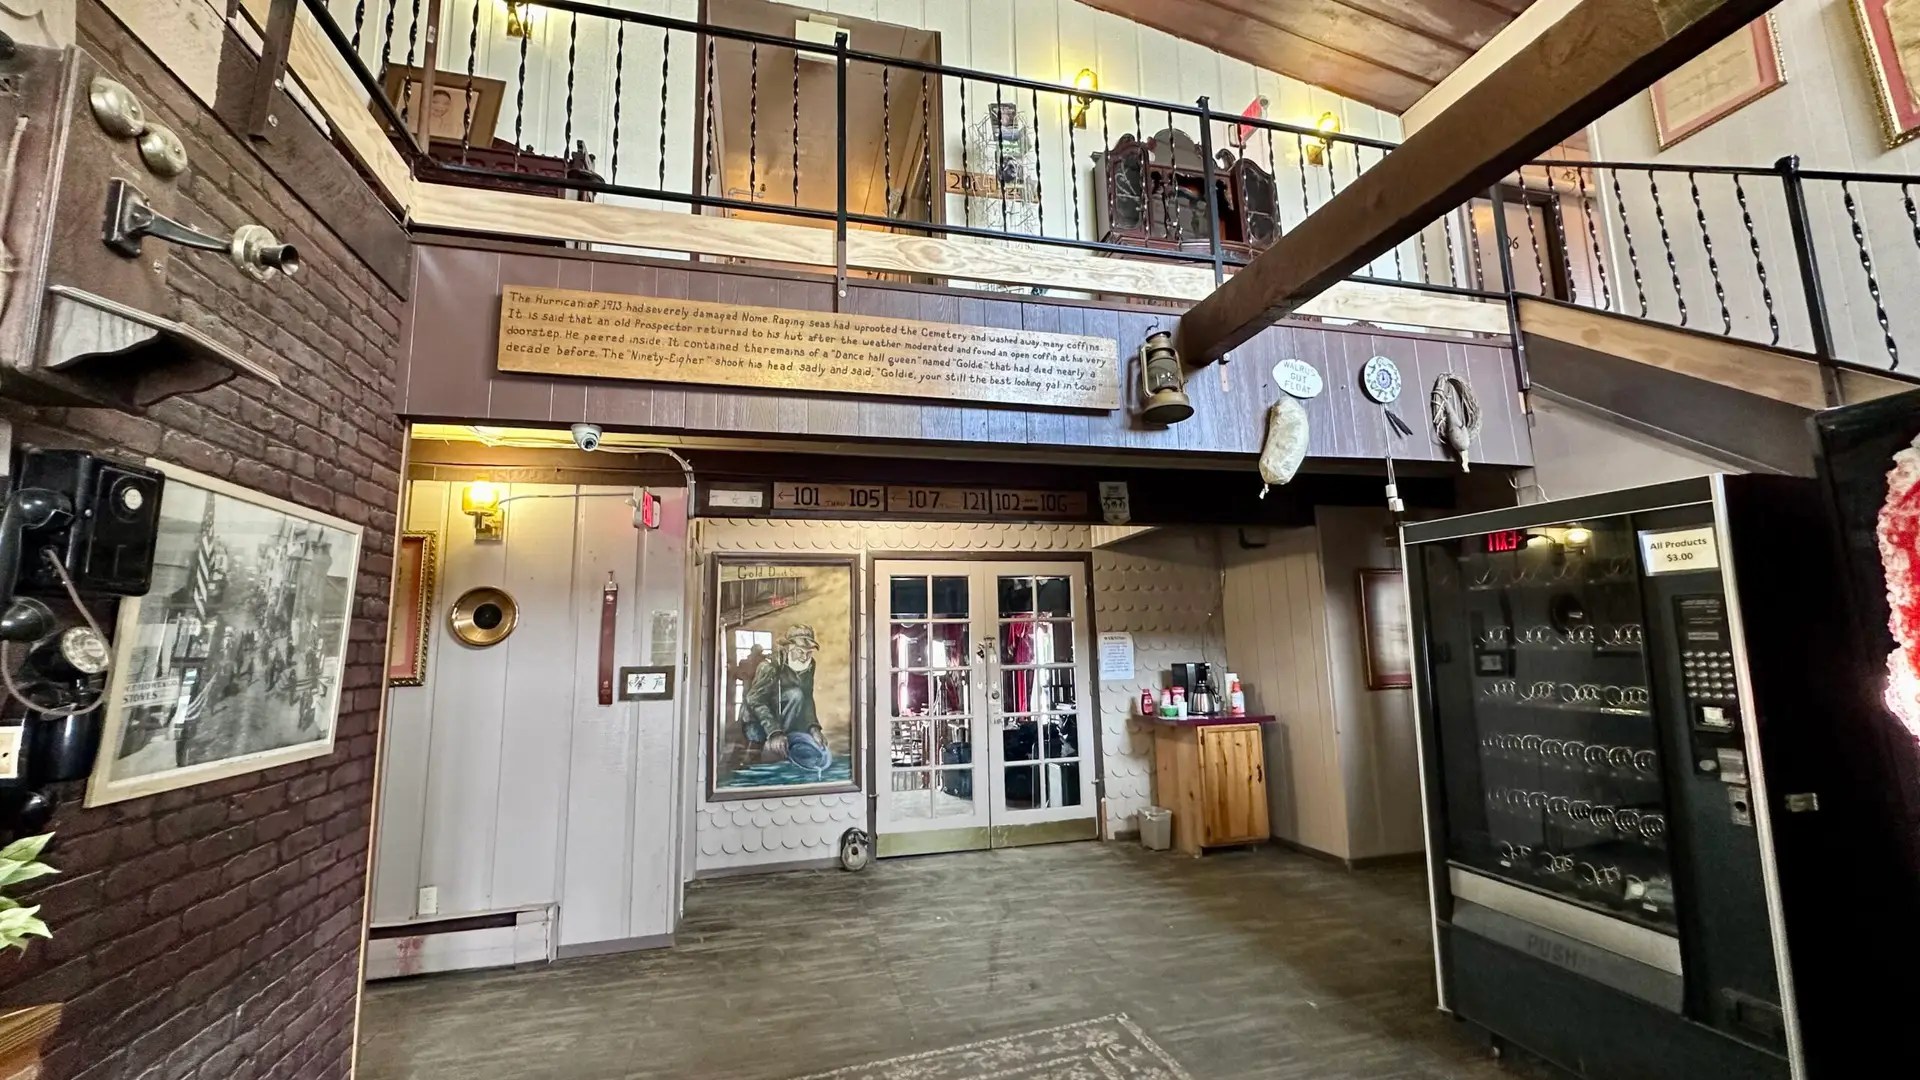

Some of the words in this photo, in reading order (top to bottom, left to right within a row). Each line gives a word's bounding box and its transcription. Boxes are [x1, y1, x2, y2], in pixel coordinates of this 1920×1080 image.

[510, 292, 530, 303] The
[586, 300, 600, 308] of
[602, 300, 622, 310] 1913
[626, 302, 644, 312] had
[646, 307, 689, 319] severely
[692, 309, 738, 321] damaged
[772, 315, 805, 327] Raging
[808, 320, 830, 328] seas
[833, 320, 850, 329] had
[854, 325, 898, 334] uprooted
[900, 326, 917, 335] the
[921, 328, 967, 342] Cemetery
[970, 333, 986, 341] and
[988, 336, 1018, 344] washed
[1042, 342, 1064, 351] many
[508, 308, 522, 319] It
[541, 313, 564, 322] said
[568, 314, 592, 324] that
[614, 318, 630, 327] old
[634, 319, 692, 332] Prospector
[696, 327, 748, 336] returned
[752, 328, 763, 337] to
[766, 330, 780, 338] his
[784, 331, 804, 340] hut
[808, 334, 836, 342] after
[840, 336, 858, 345] the
[862, 339, 901, 347] weather
[904, 343, 954, 352] moderated
[956, 344, 971, 354] and
[972, 347, 996, 356] found
[1010, 352, 1030, 360] open
[1032, 352, 1057, 360] coffin
[1072, 354, 1083, 362] his
[1086, 358, 1106, 368] very
[565, 330, 579, 339] He
[583, 335, 625, 343] peered
[668, 337, 679, 346] It
[683, 341, 739, 351] contained
[808, 348, 820, 356] of
[868, 353, 884, 361] hall
[990, 361, 1011, 371] that
[1013, 364, 1030, 372] had
[1033, 365, 1053, 374] died
[1056, 368, 1085, 380] nearly
[506, 343, 550, 354] decade
[601, 348, 624, 359] The
[714, 357, 744, 366] shook
[748, 359, 762, 368] his
[767, 360, 792, 370] head
[798, 364, 826, 376] sadly
[830, 366, 848, 374] and
[919, 375, 942, 383] your
[944, 373, 966, 382] still
[968, 374, 986, 384] the
[989, 376, 1012, 384] best
[1014, 378, 1042, 390] looking
[1045, 381, 1060, 390] gal
[1284, 361, 1316, 376] WALRUS
[1285, 380, 1311, 393] FLOAT
[1291, 372, 1306, 383] GUT
[793, 486, 820, 505] 101
[850, 488, 880, 508] 105
[908, 490, 940, 509] 107
[963, 491, 986, 510] 121
[996, 493, 1020, 511] 102
[1650, 542, 1663, 550] All
[1665, 538, 1707, 548] Products
[1666, 552, 1693, 562] $3.00
[1527, 934, 1577, 968] PUSH
